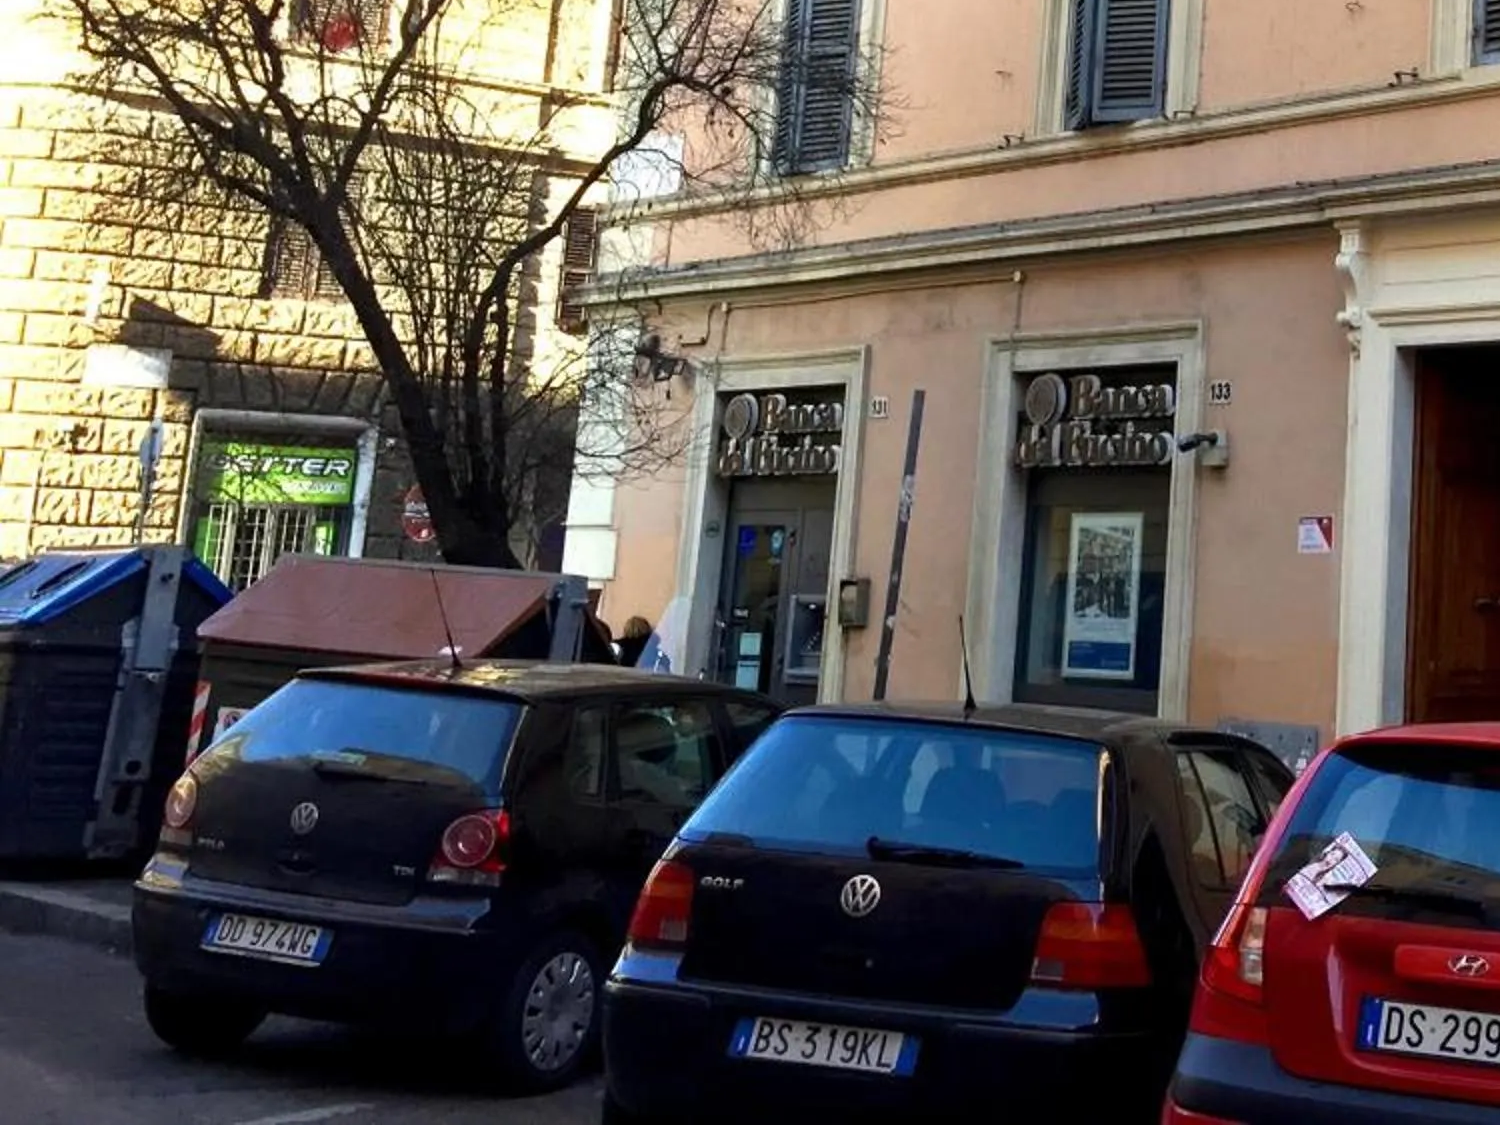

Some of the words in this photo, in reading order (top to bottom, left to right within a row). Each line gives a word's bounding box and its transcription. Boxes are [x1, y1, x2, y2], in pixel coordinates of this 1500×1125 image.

[1069, 375, 1176, 419] Banca
[1210, 382, 1232, 401] 133
[761, 393, 844, 432] Banca
[700, 876, 745, 890] GOLF
[252, 922, 318, 955] 974WG
[753, 1020, 793, 1056] BS
[799, 1026, 894, 1069] 319KL
[1383, 1006, 1427, 1048] DS
